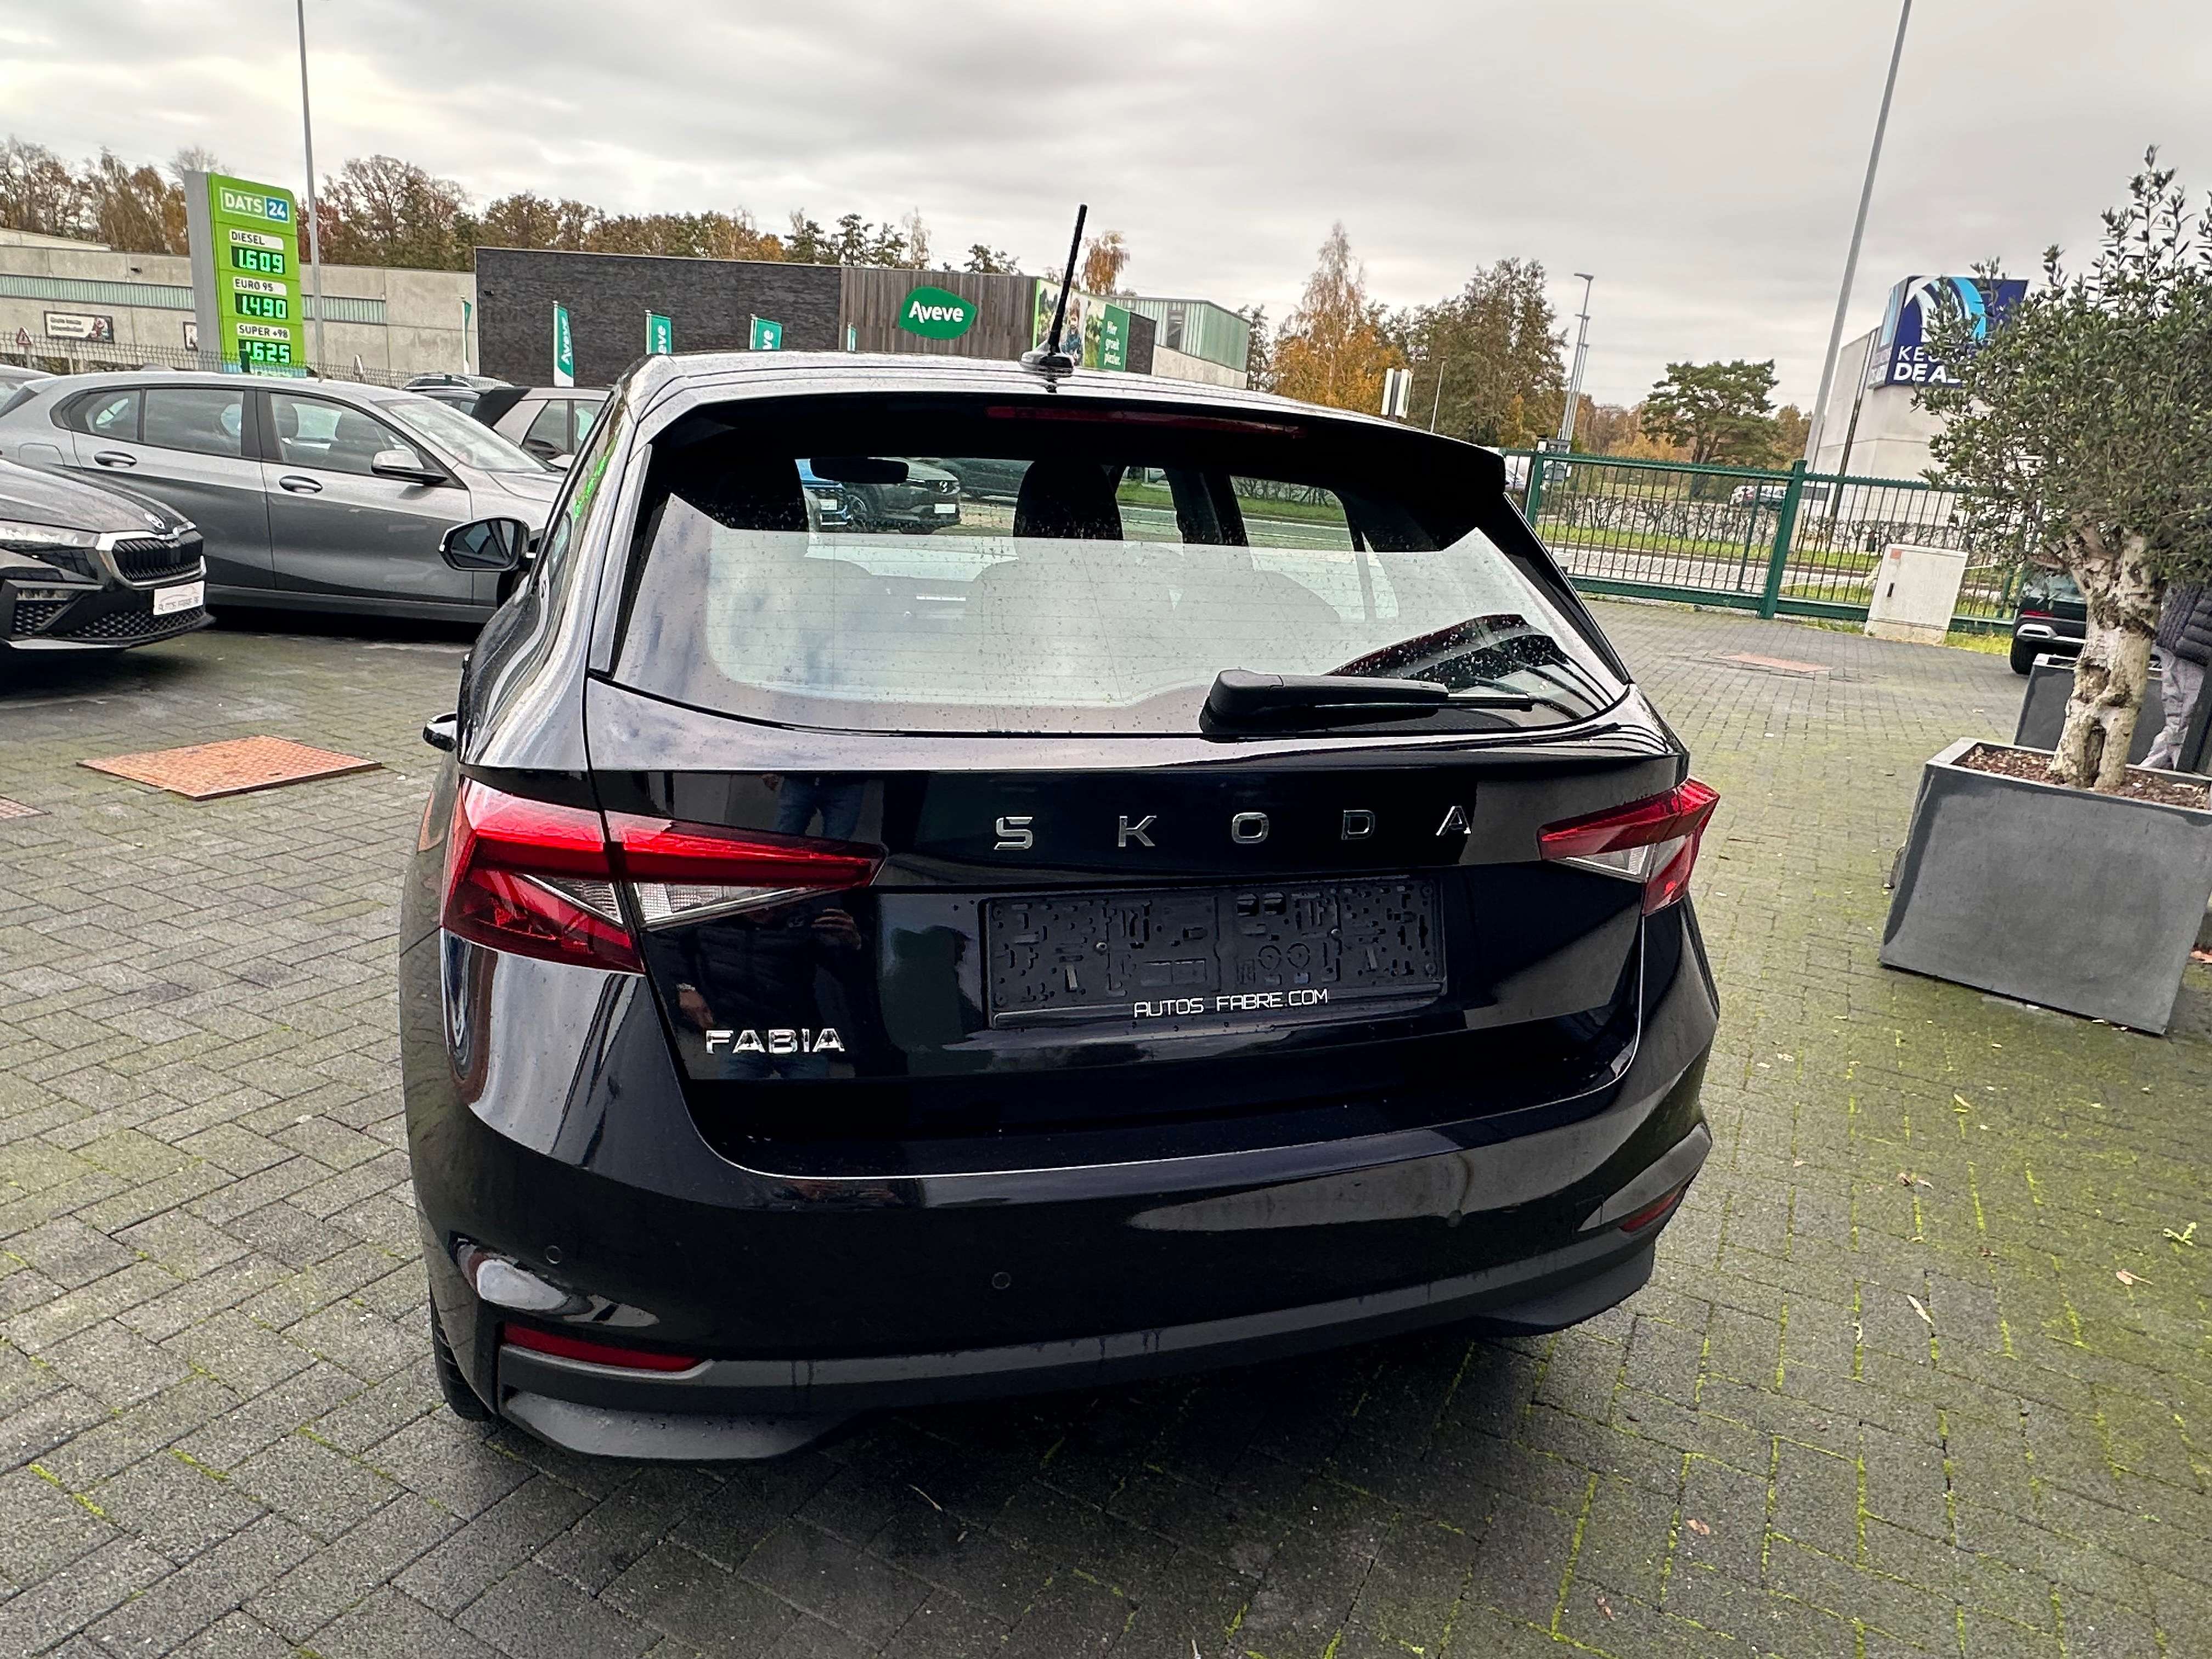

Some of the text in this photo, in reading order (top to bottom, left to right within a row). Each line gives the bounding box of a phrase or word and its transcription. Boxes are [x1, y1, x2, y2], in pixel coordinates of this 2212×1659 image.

[224, 192, 286, 218] DATS 24
[231, 231, 266, 245] DIESEL
[235, 278, 274, 292] EURO 95
[909, 301, 964, 324] Aveve
[239, 324, 270, 337] SUPER
[1133, 988, 1329, 1018] AUTOS FABRE.COM
[705, 1028, 846, 1054] FABIA
